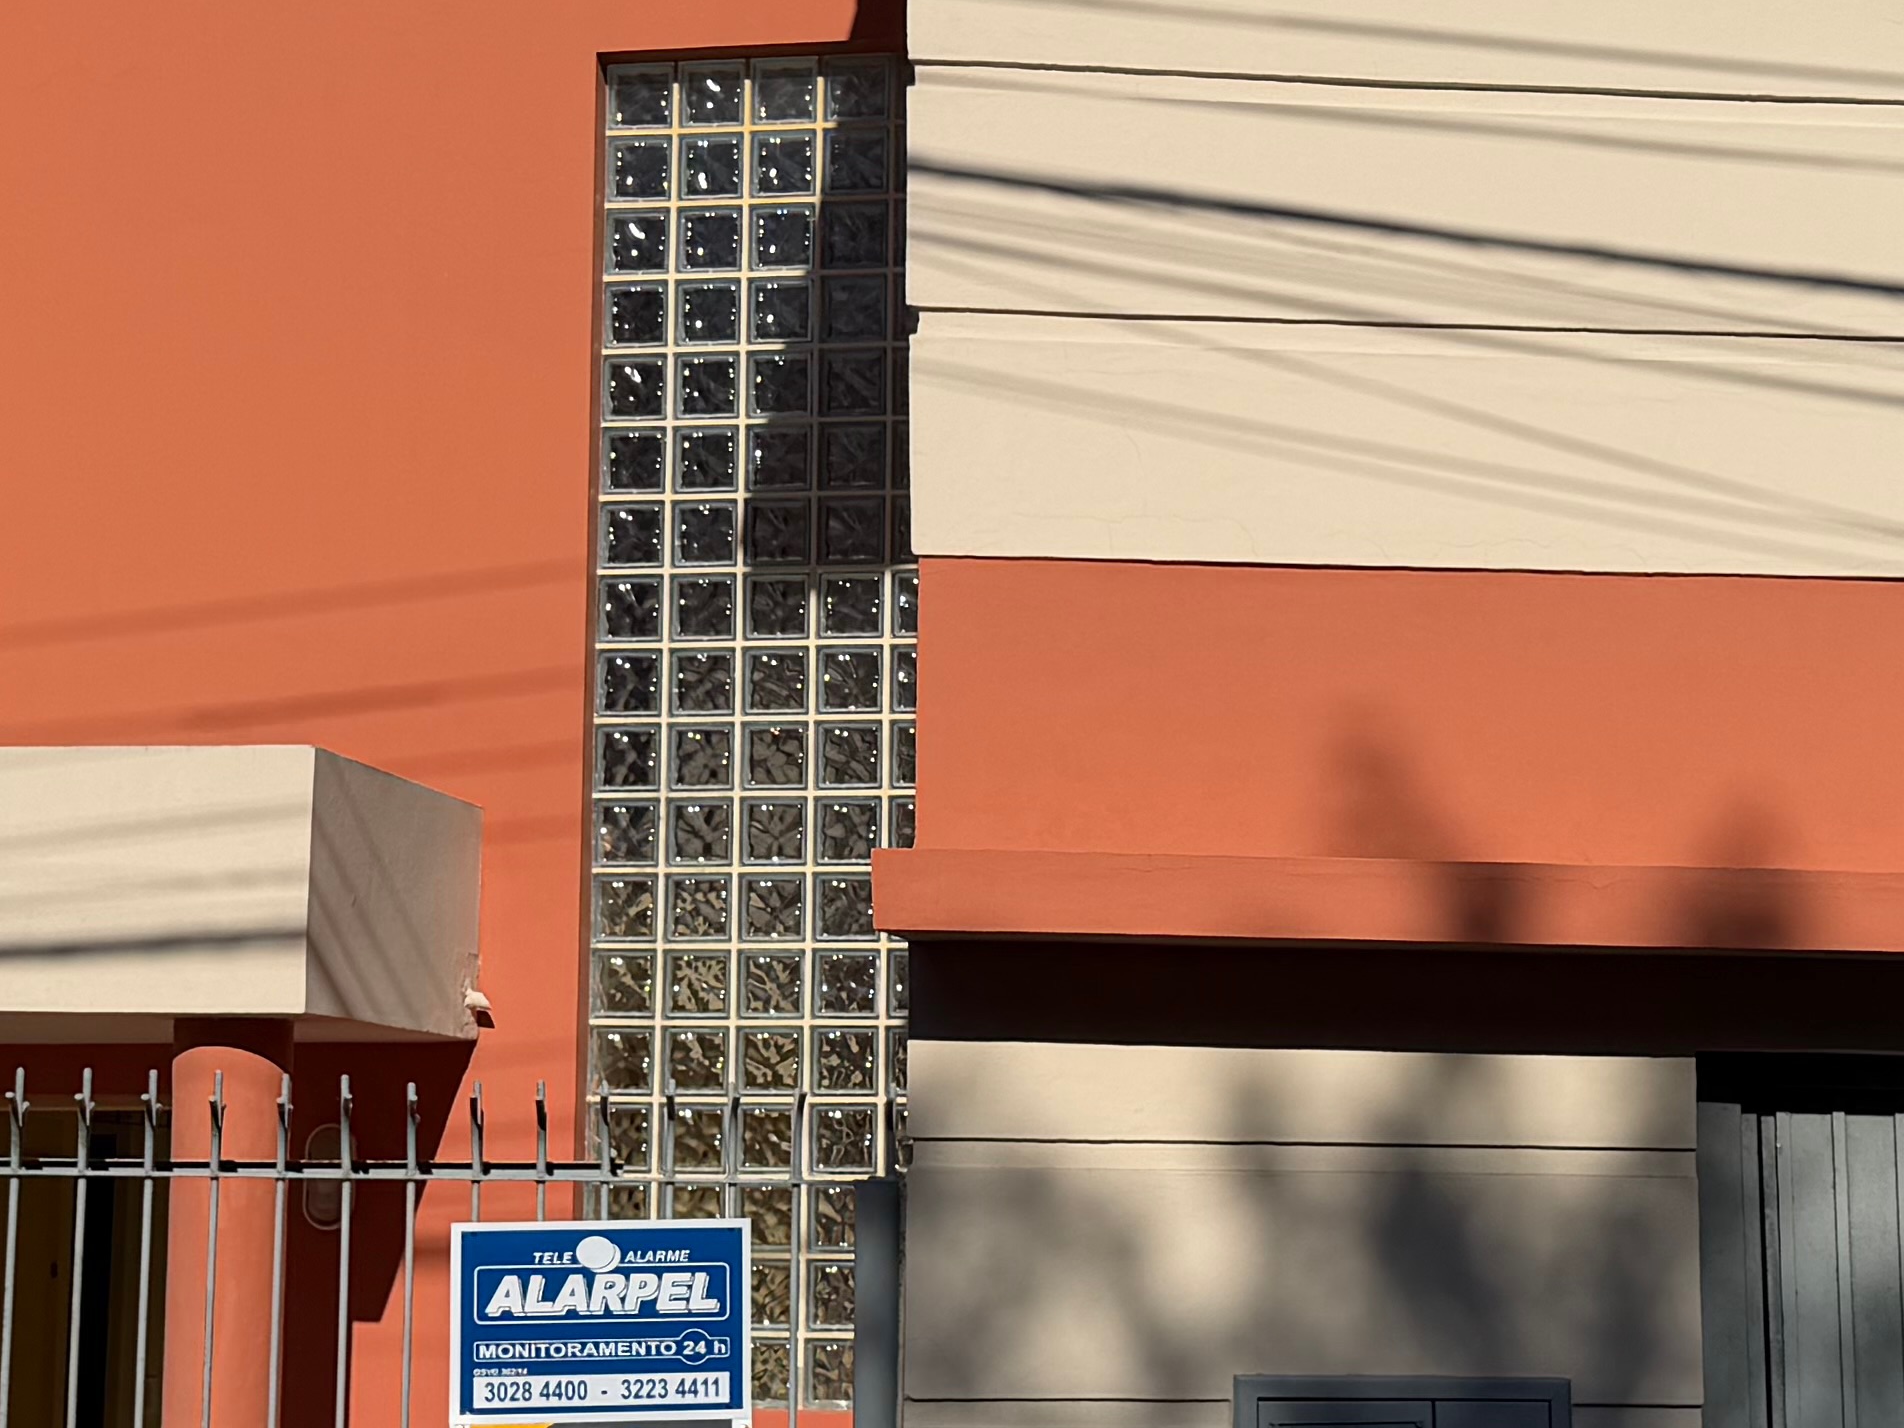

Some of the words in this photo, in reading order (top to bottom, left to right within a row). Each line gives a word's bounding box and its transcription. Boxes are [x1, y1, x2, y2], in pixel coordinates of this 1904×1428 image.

[533, 1251, 573, 1264] TELE
[624, 1250, 690, 1263] ALARME
[485, 1272, 720, 1317] ALARPEL
[479, 1341, 677, 1359] MONITORAMENTO
[682, 1341, 707, 1354] 24
[714, 1342, 726, 1354] h
[484, 1382, 532, 1402] 3028
[539, 1380, 588, 1401] 4400
[621, 1379, 668, 1399] 3223
[675, 1377, 720, 1398] 4411
